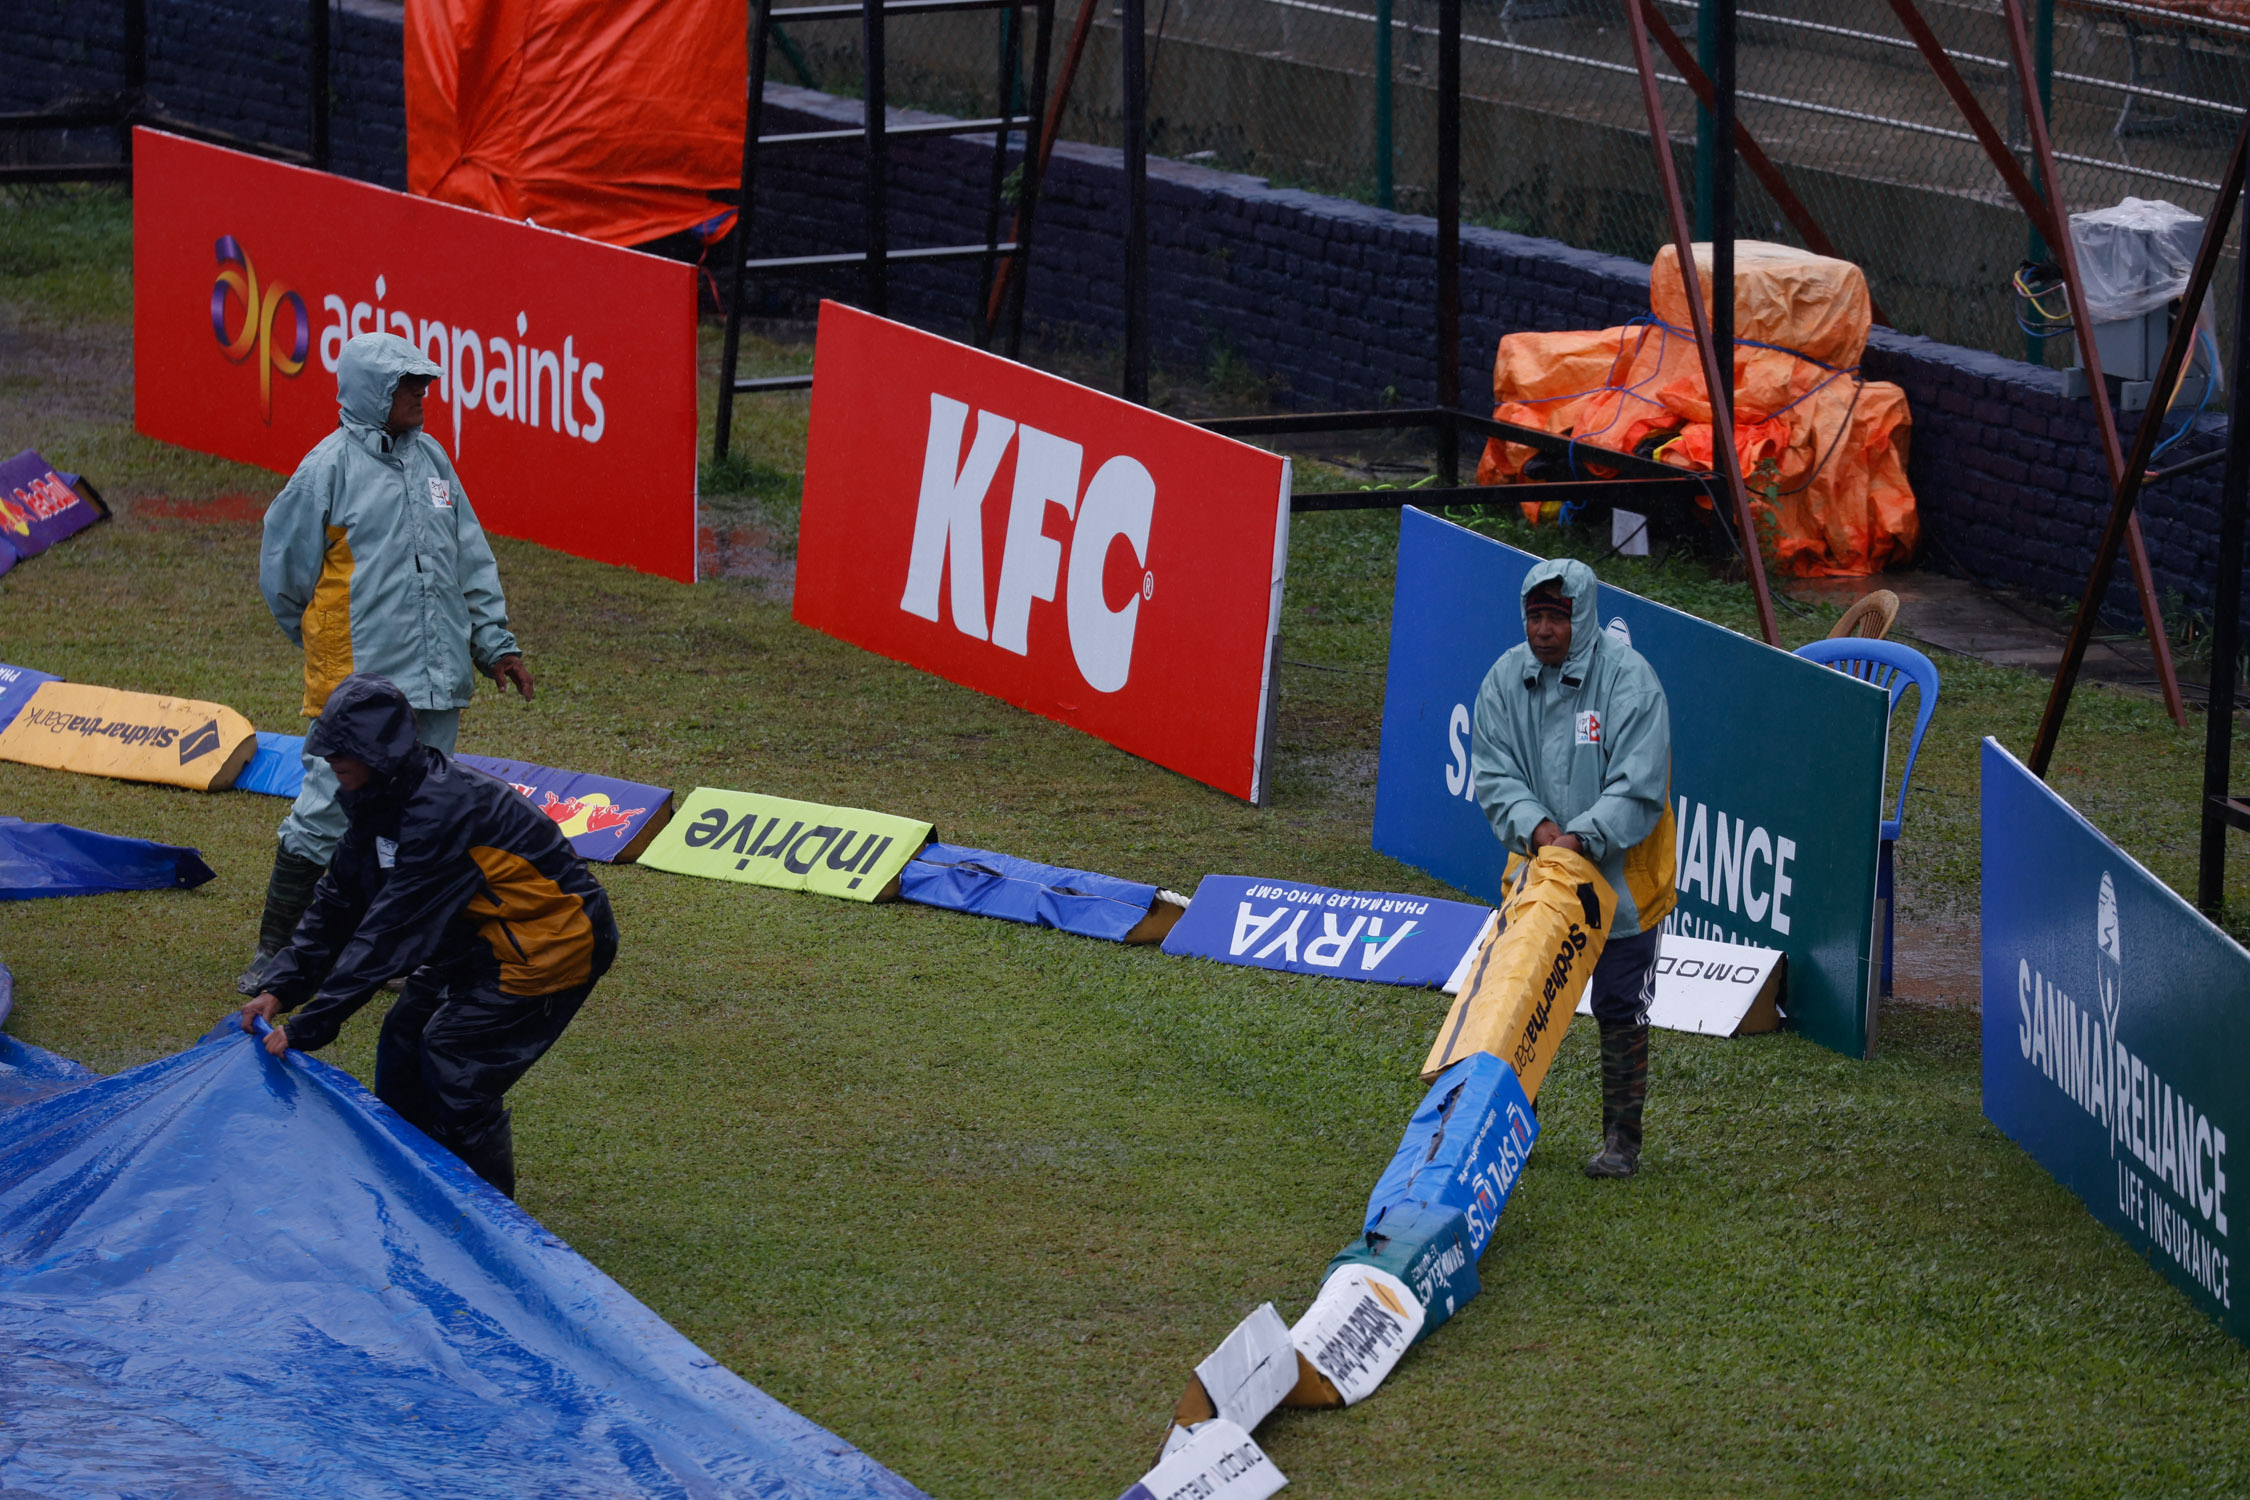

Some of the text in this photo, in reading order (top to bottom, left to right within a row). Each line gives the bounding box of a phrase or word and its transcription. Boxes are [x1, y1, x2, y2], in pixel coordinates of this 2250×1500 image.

[900, 392, 1156, 693] KFC
[685, 807, 893, 889] inDrive
[1246, 883, 1429, 915] PHARMALAB WHO-GMP
[1675, 795, 1796, 936] IANCE
[1228, 902, 1425, 970] ARYA
[1657, 956, 1760, 984] OMOD
[2018, 957, 2229, 1237] SANIMA RELIANCE
[2118, 1159, 2231, 1309] LIFE INSURANCE
